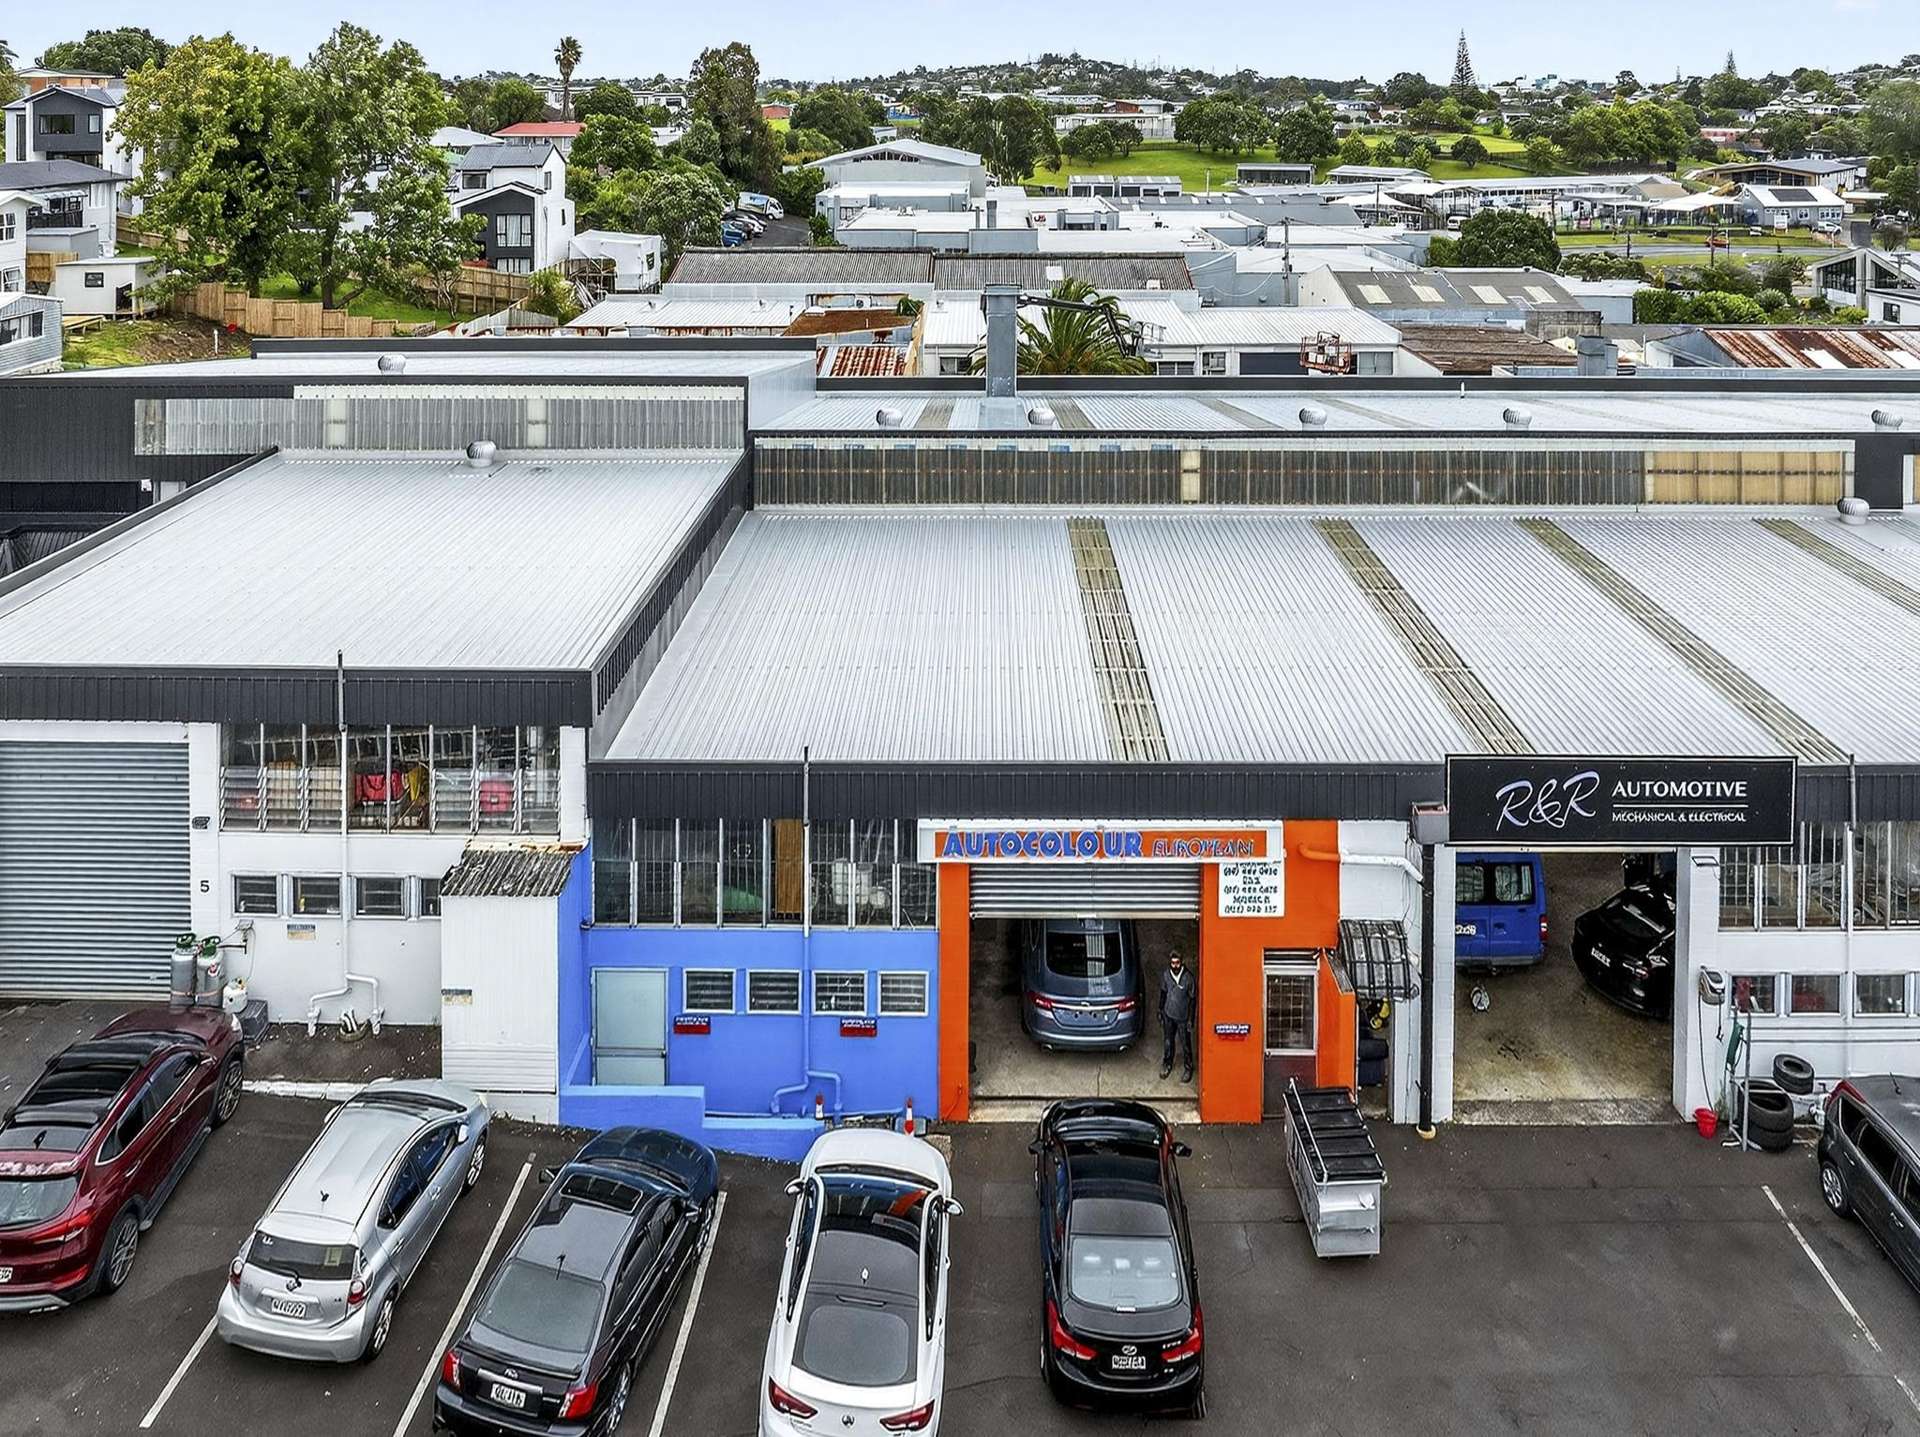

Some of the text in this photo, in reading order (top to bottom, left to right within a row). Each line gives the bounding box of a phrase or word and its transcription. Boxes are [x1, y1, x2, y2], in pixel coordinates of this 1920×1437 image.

[1611, 780, 1748, 798] AUTOMOTIVE
[1495, 770, 1601, 832] R&R
[1612, 811, 1747, 822] MECHANICAL & ELECTRICAL
[943, 831, 1144, 858] AUTOCOLOUR
[200, 879, 210, 893] 5
